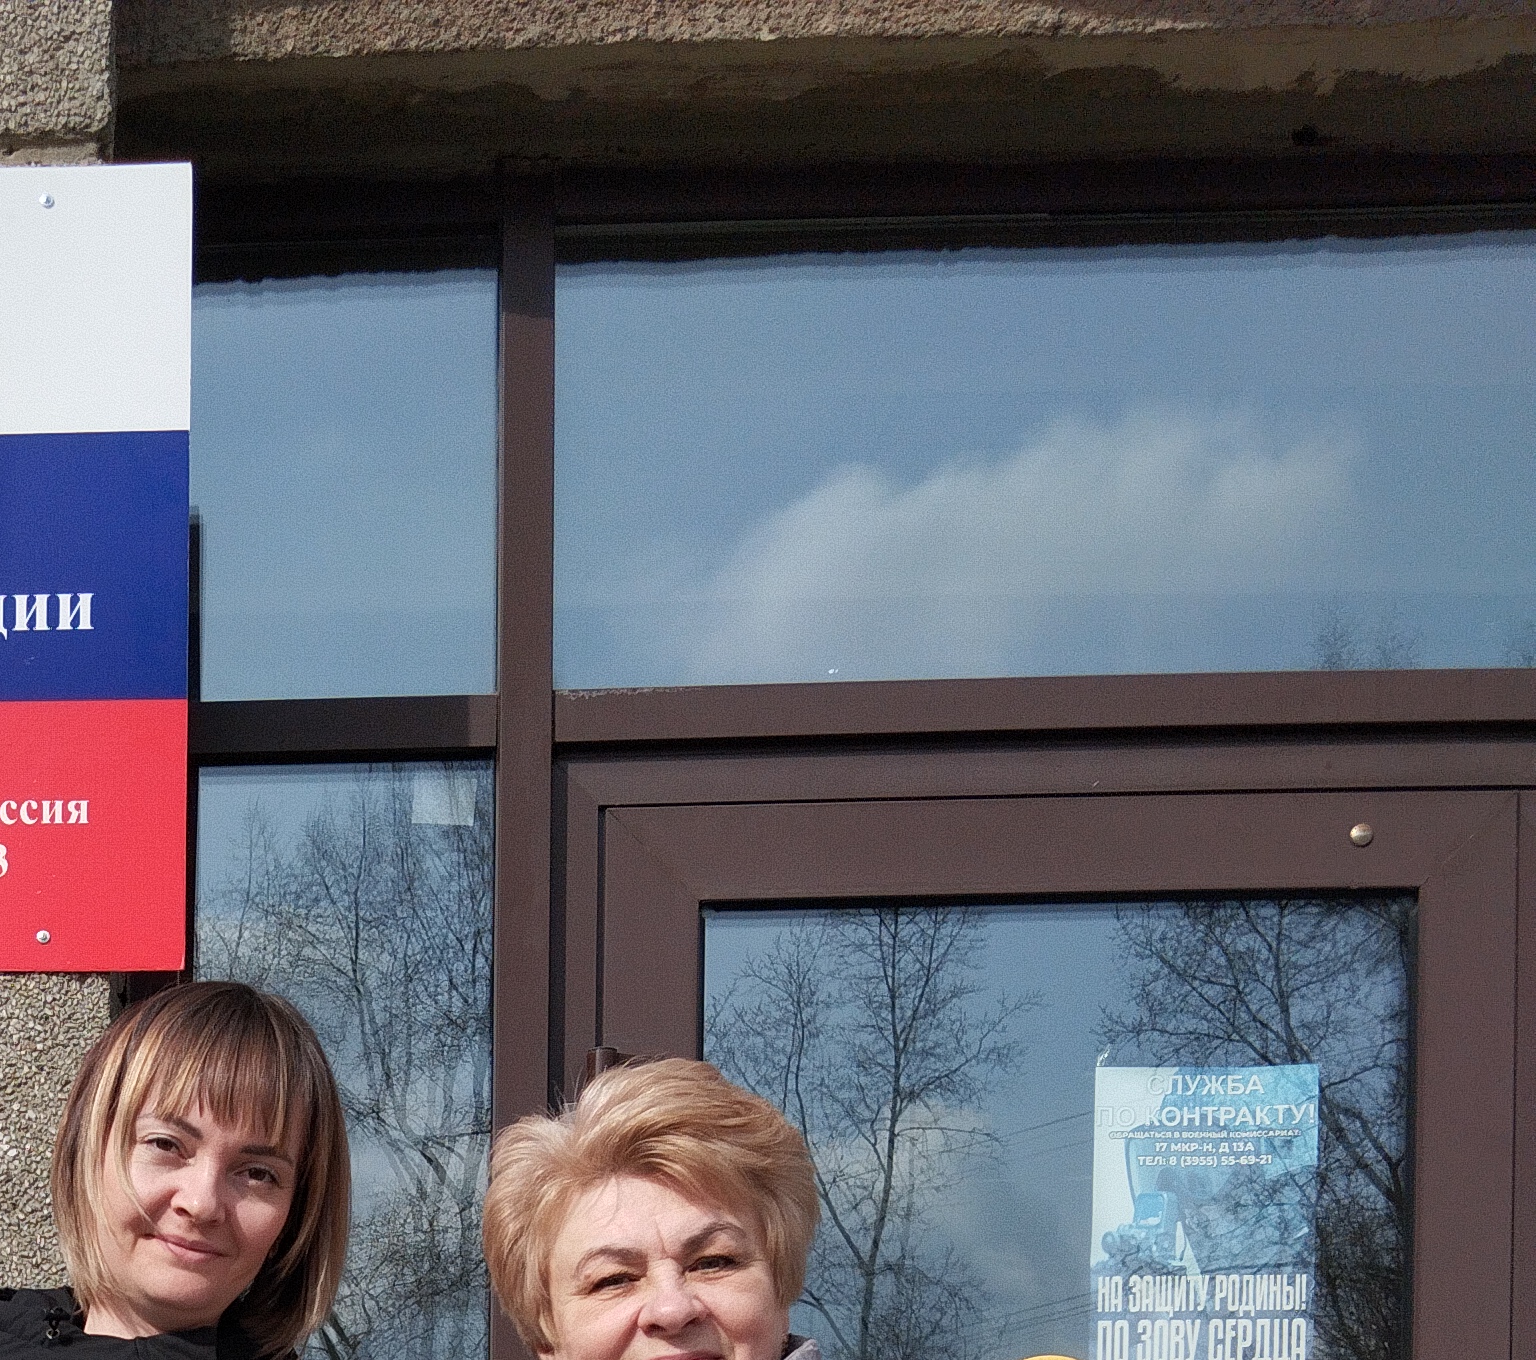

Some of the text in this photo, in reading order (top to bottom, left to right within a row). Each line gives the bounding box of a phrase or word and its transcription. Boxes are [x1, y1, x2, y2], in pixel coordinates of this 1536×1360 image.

[1148, 1074, 1265, 1096] СЛУЖБА
[1096, 1103, 1315, 1127] ПО КОНТРАКТУ!
[1109, 1131, 1172, 1139] ОБРАЩАТЬСЯ
[1174, 1131, 1180, 1139] В
[1181, 1130, 1227, 1139] ВОЕННЫЙ
[1155, 1142, 1255, 1154] 17 МКР-Н, Д 13А
[1138, 1154, 1272, 1168] ТЕЛ: 8 (3955) 55-69-21
[1097, 1273, 1307, 1317] НА ЗАЩИТУ РОДИНЫ!
